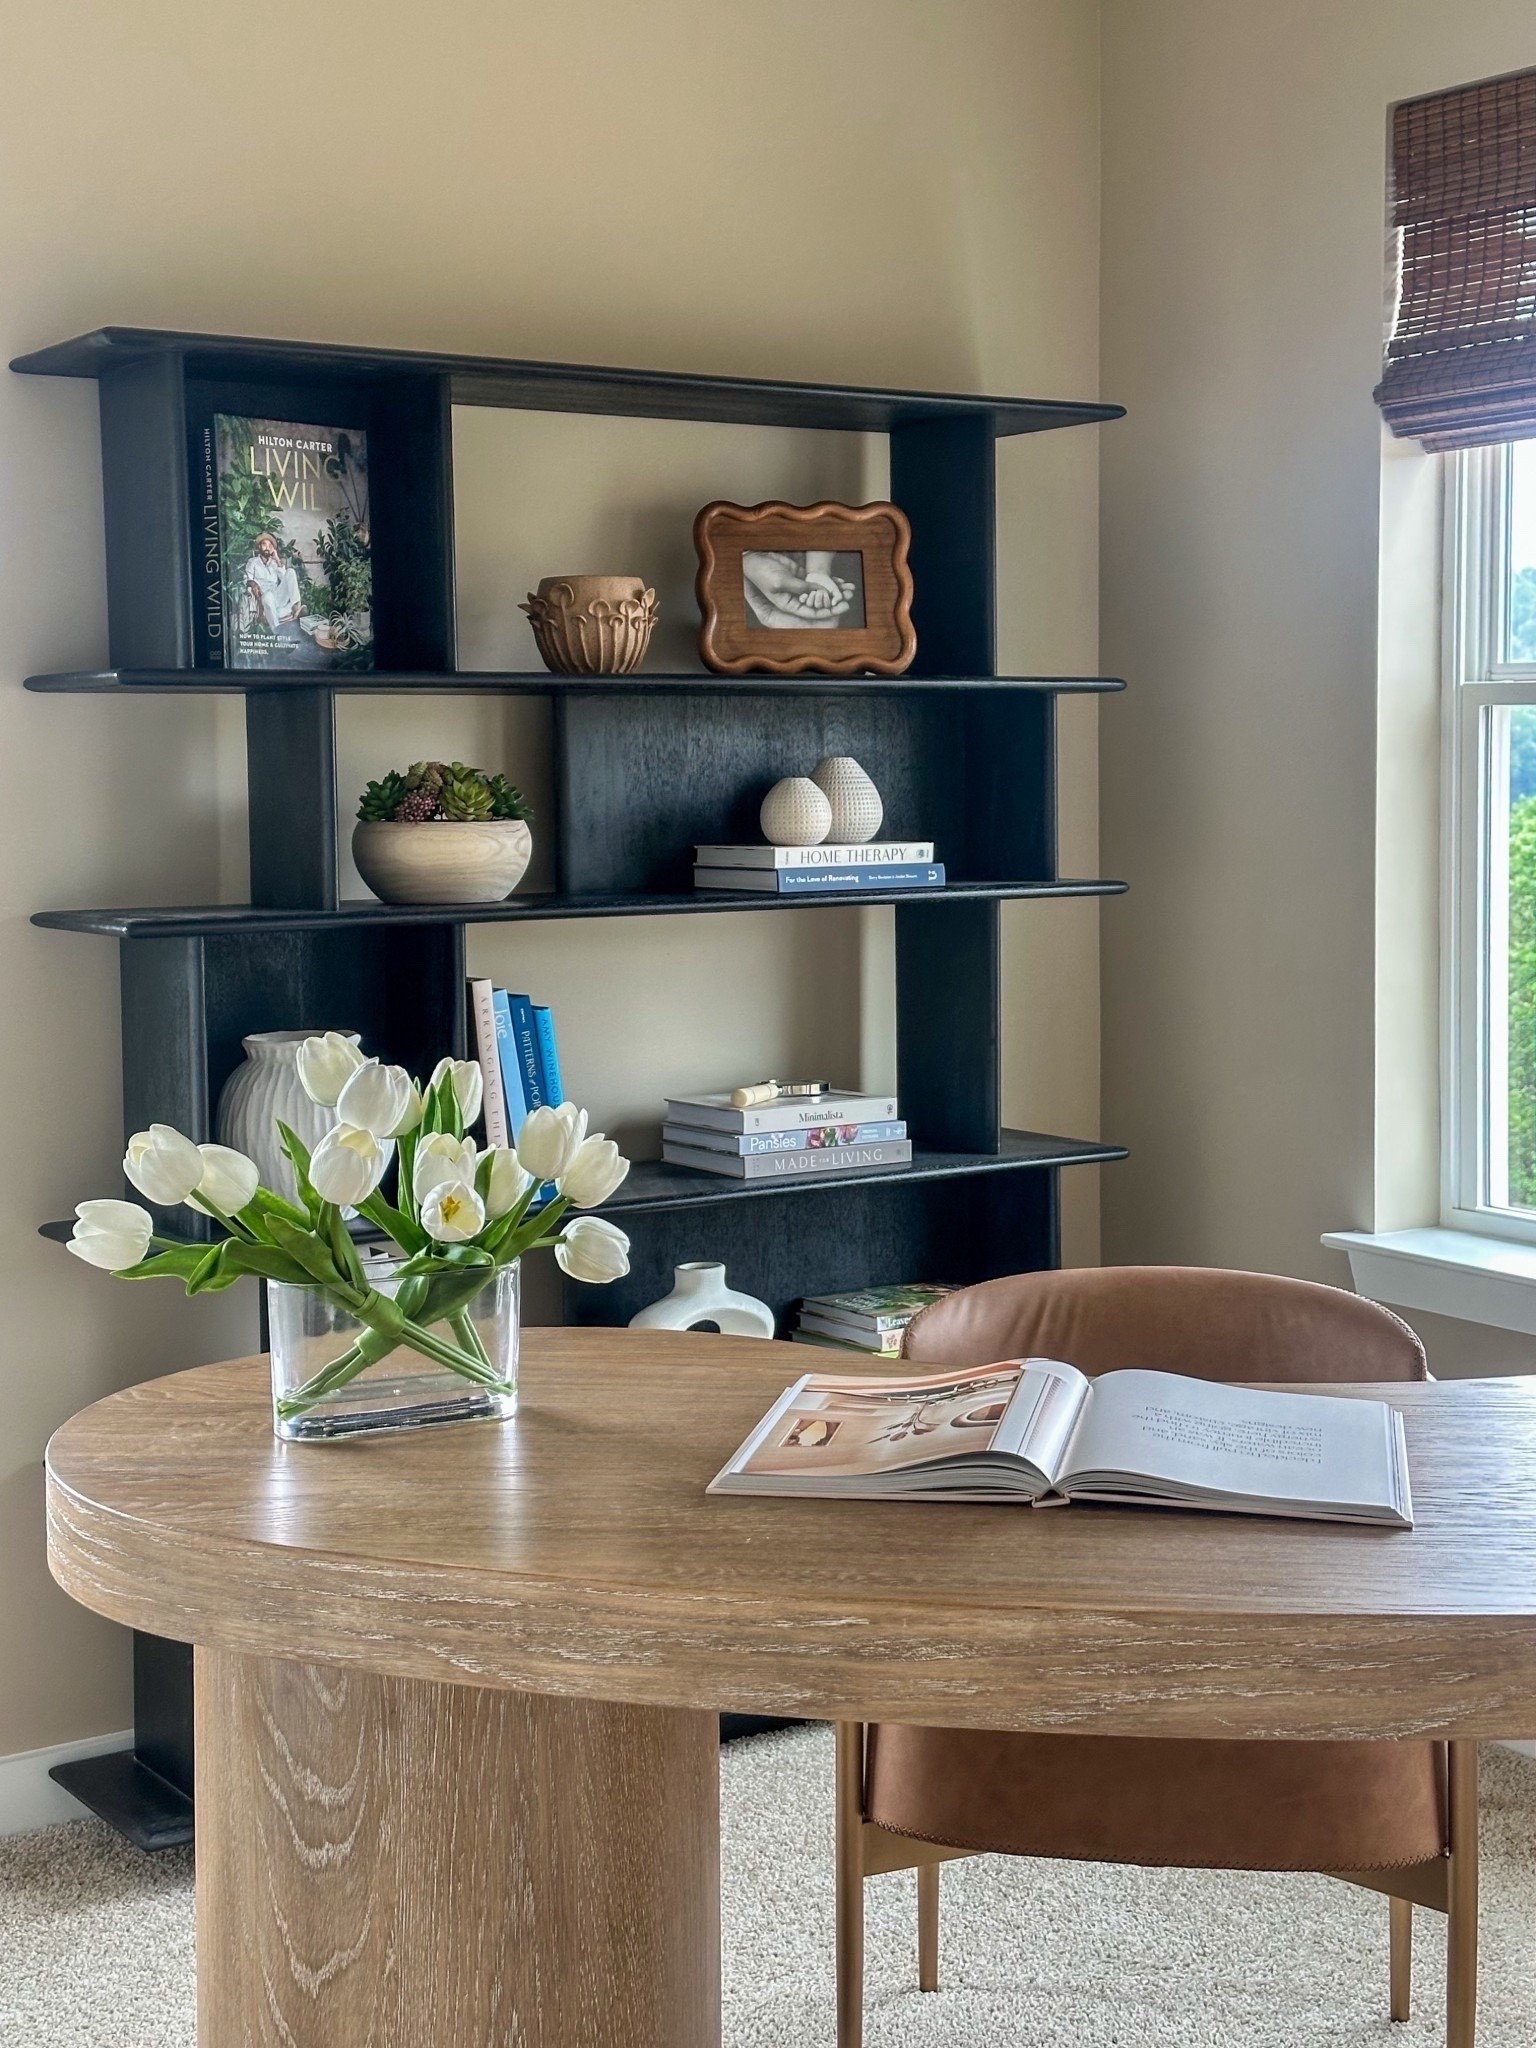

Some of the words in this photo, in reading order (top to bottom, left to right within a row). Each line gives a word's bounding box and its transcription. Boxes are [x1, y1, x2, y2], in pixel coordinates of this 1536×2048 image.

[203, 428, 212, 461] HILTON
[258, 435, 293, 448] HILTON
[296, 439, 333, 452] CARTER
[250, 446, 342, 481] LIVING
[205, 464, 213, 501] CARTER
[267, 478, 323, 511] WIL
[203, 504, 220, 574] LIVING
[206, 580, 222, 638] WILD
[800, 849, 842, 864] HOME
[846, 847, 907, 863] THERAPY
[806, 875, 820, 883] Love
[828, 873, 859, 884] Renovating
[542, 1018, 553, 1043] AMY
[481, 996, 497, 1100] ARRANGING
[521, 1030, 537, 1079] PATTERNS
[530, 1085, 542, 1108] POR
[798, 1110, 844, 1123] Minimalista
[750, 1134, 797, 1151] Pansies
[774, 1155, 817, 1172] MADE
[832, 1149, 883, 1166] LIVING
[888, 1316, 911, 1327] Leave
